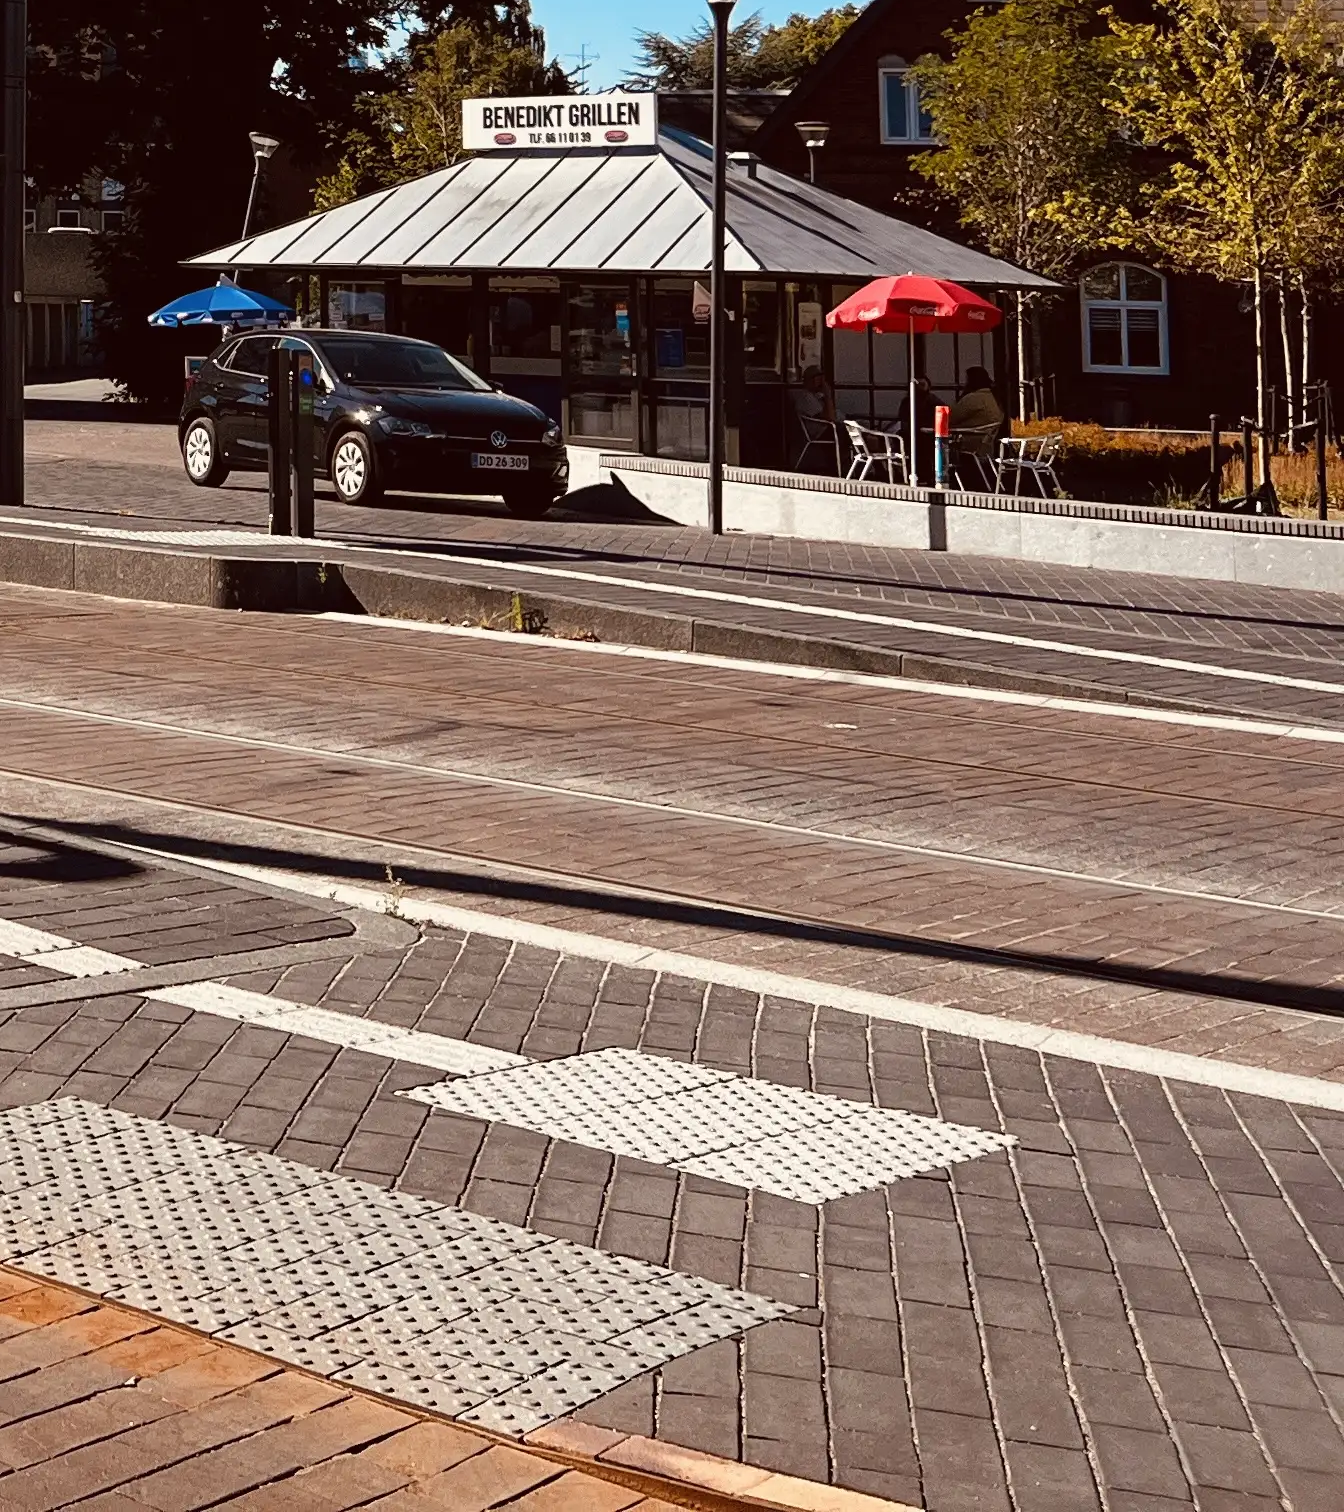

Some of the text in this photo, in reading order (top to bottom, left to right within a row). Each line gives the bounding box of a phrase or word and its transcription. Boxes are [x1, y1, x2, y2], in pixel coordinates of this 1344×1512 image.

[482, 102, 641, 129] BENEDIKT GRILLEN
[479, 455, 528, 469] DD 26 309
